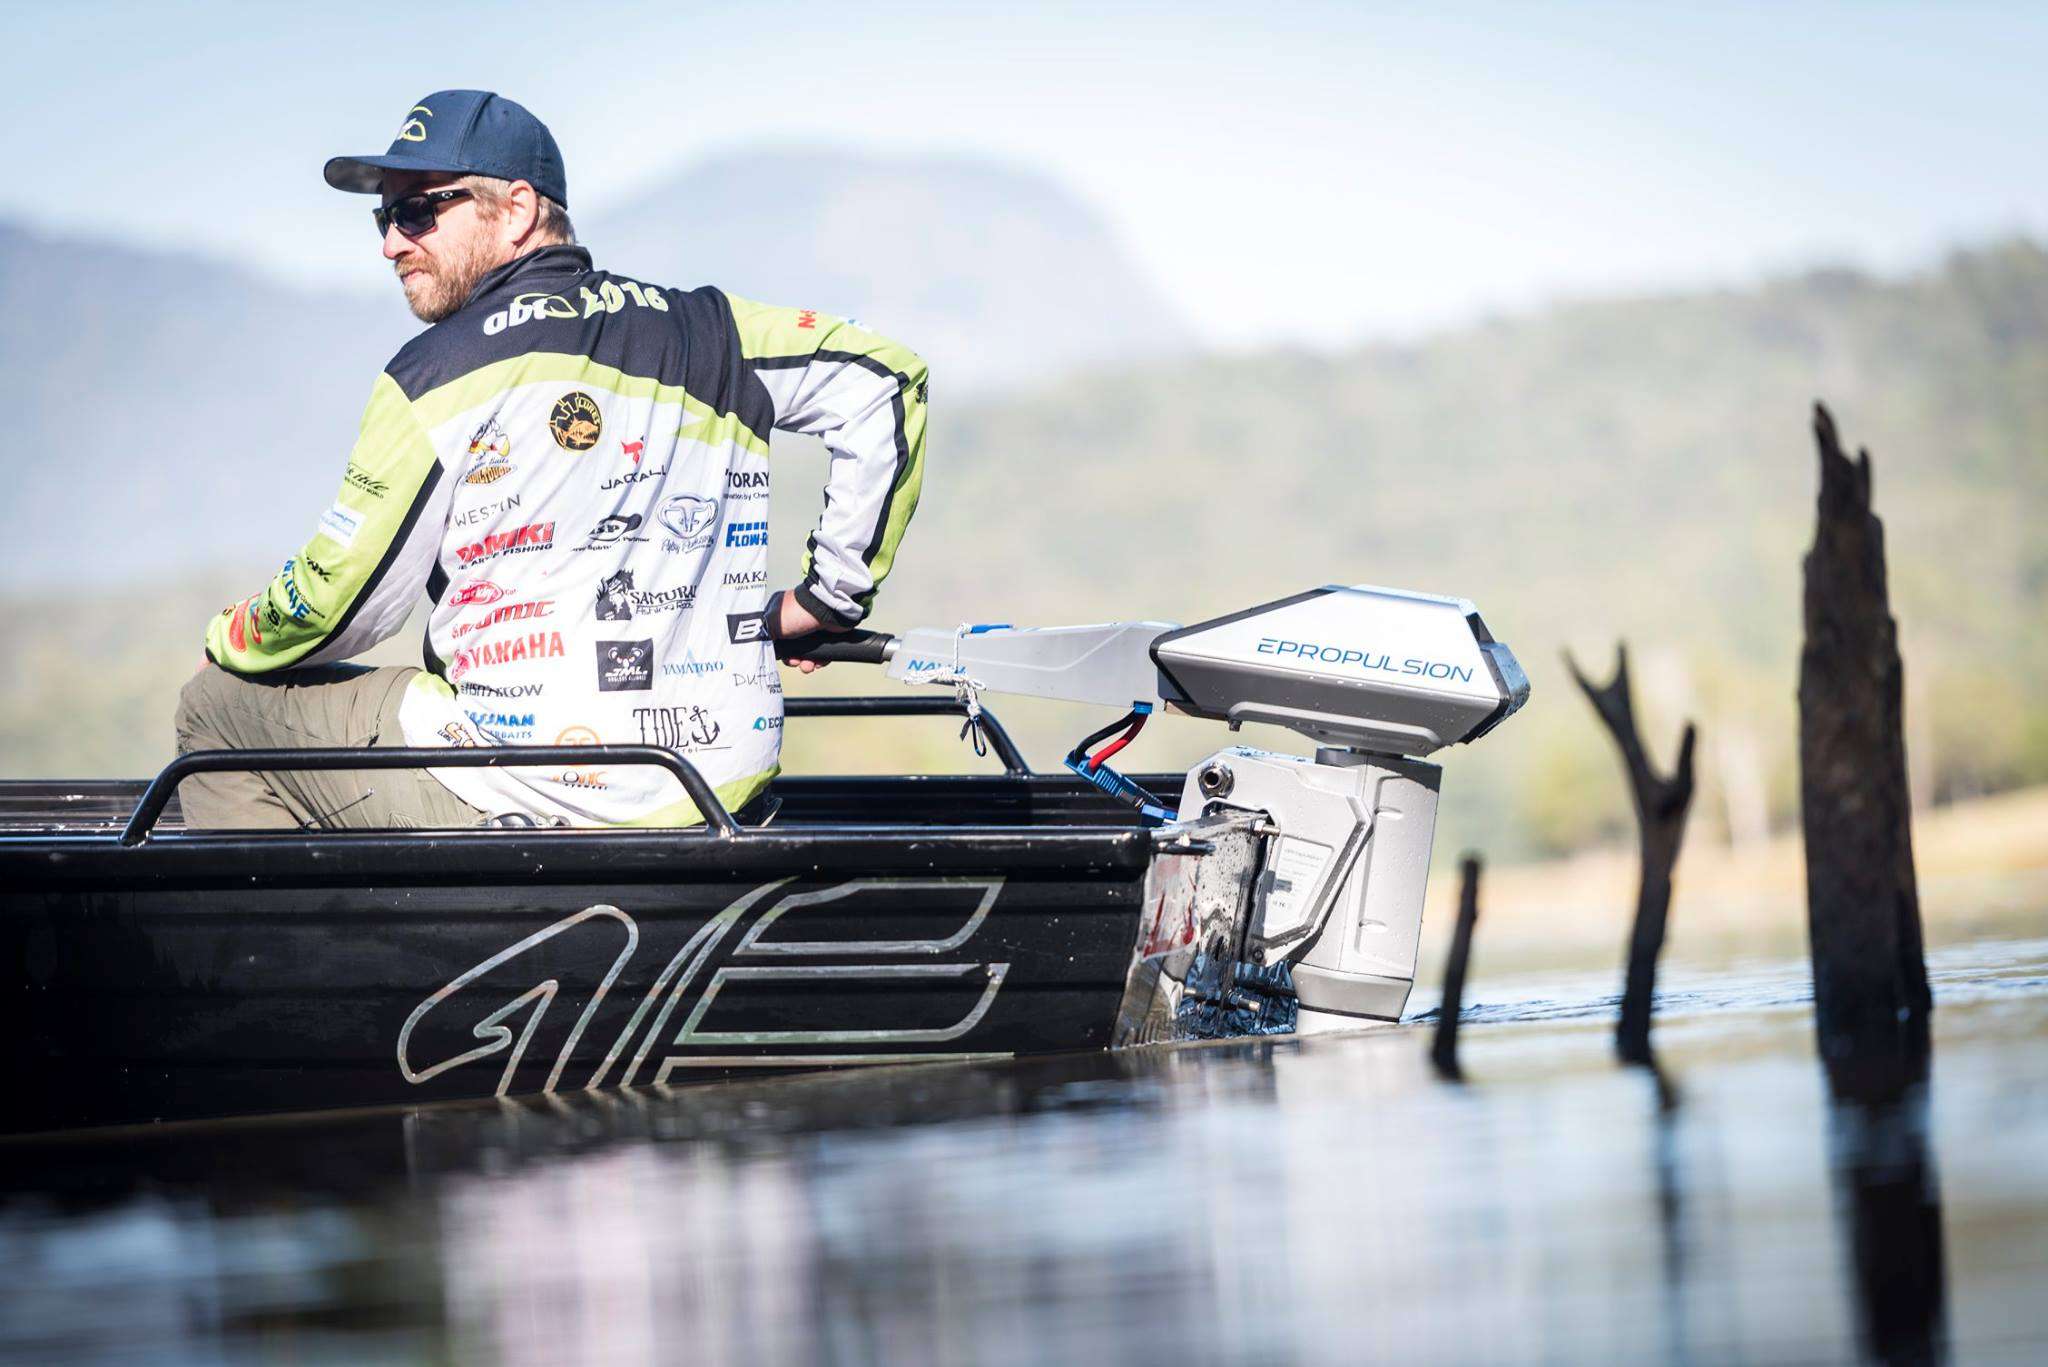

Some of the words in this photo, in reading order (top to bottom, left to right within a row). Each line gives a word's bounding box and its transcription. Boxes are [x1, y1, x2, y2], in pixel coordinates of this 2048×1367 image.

[580, 281, 669, 319] 2016
[503, 543, 553, 556] FISHING
[469, 632, 565, 668] YAMAHA
[663, 661, 724, 676] YAMATOYO
[1257, 638, 1473, 682] EPROPULSION
[632, 706, 689, 748] TIDE
